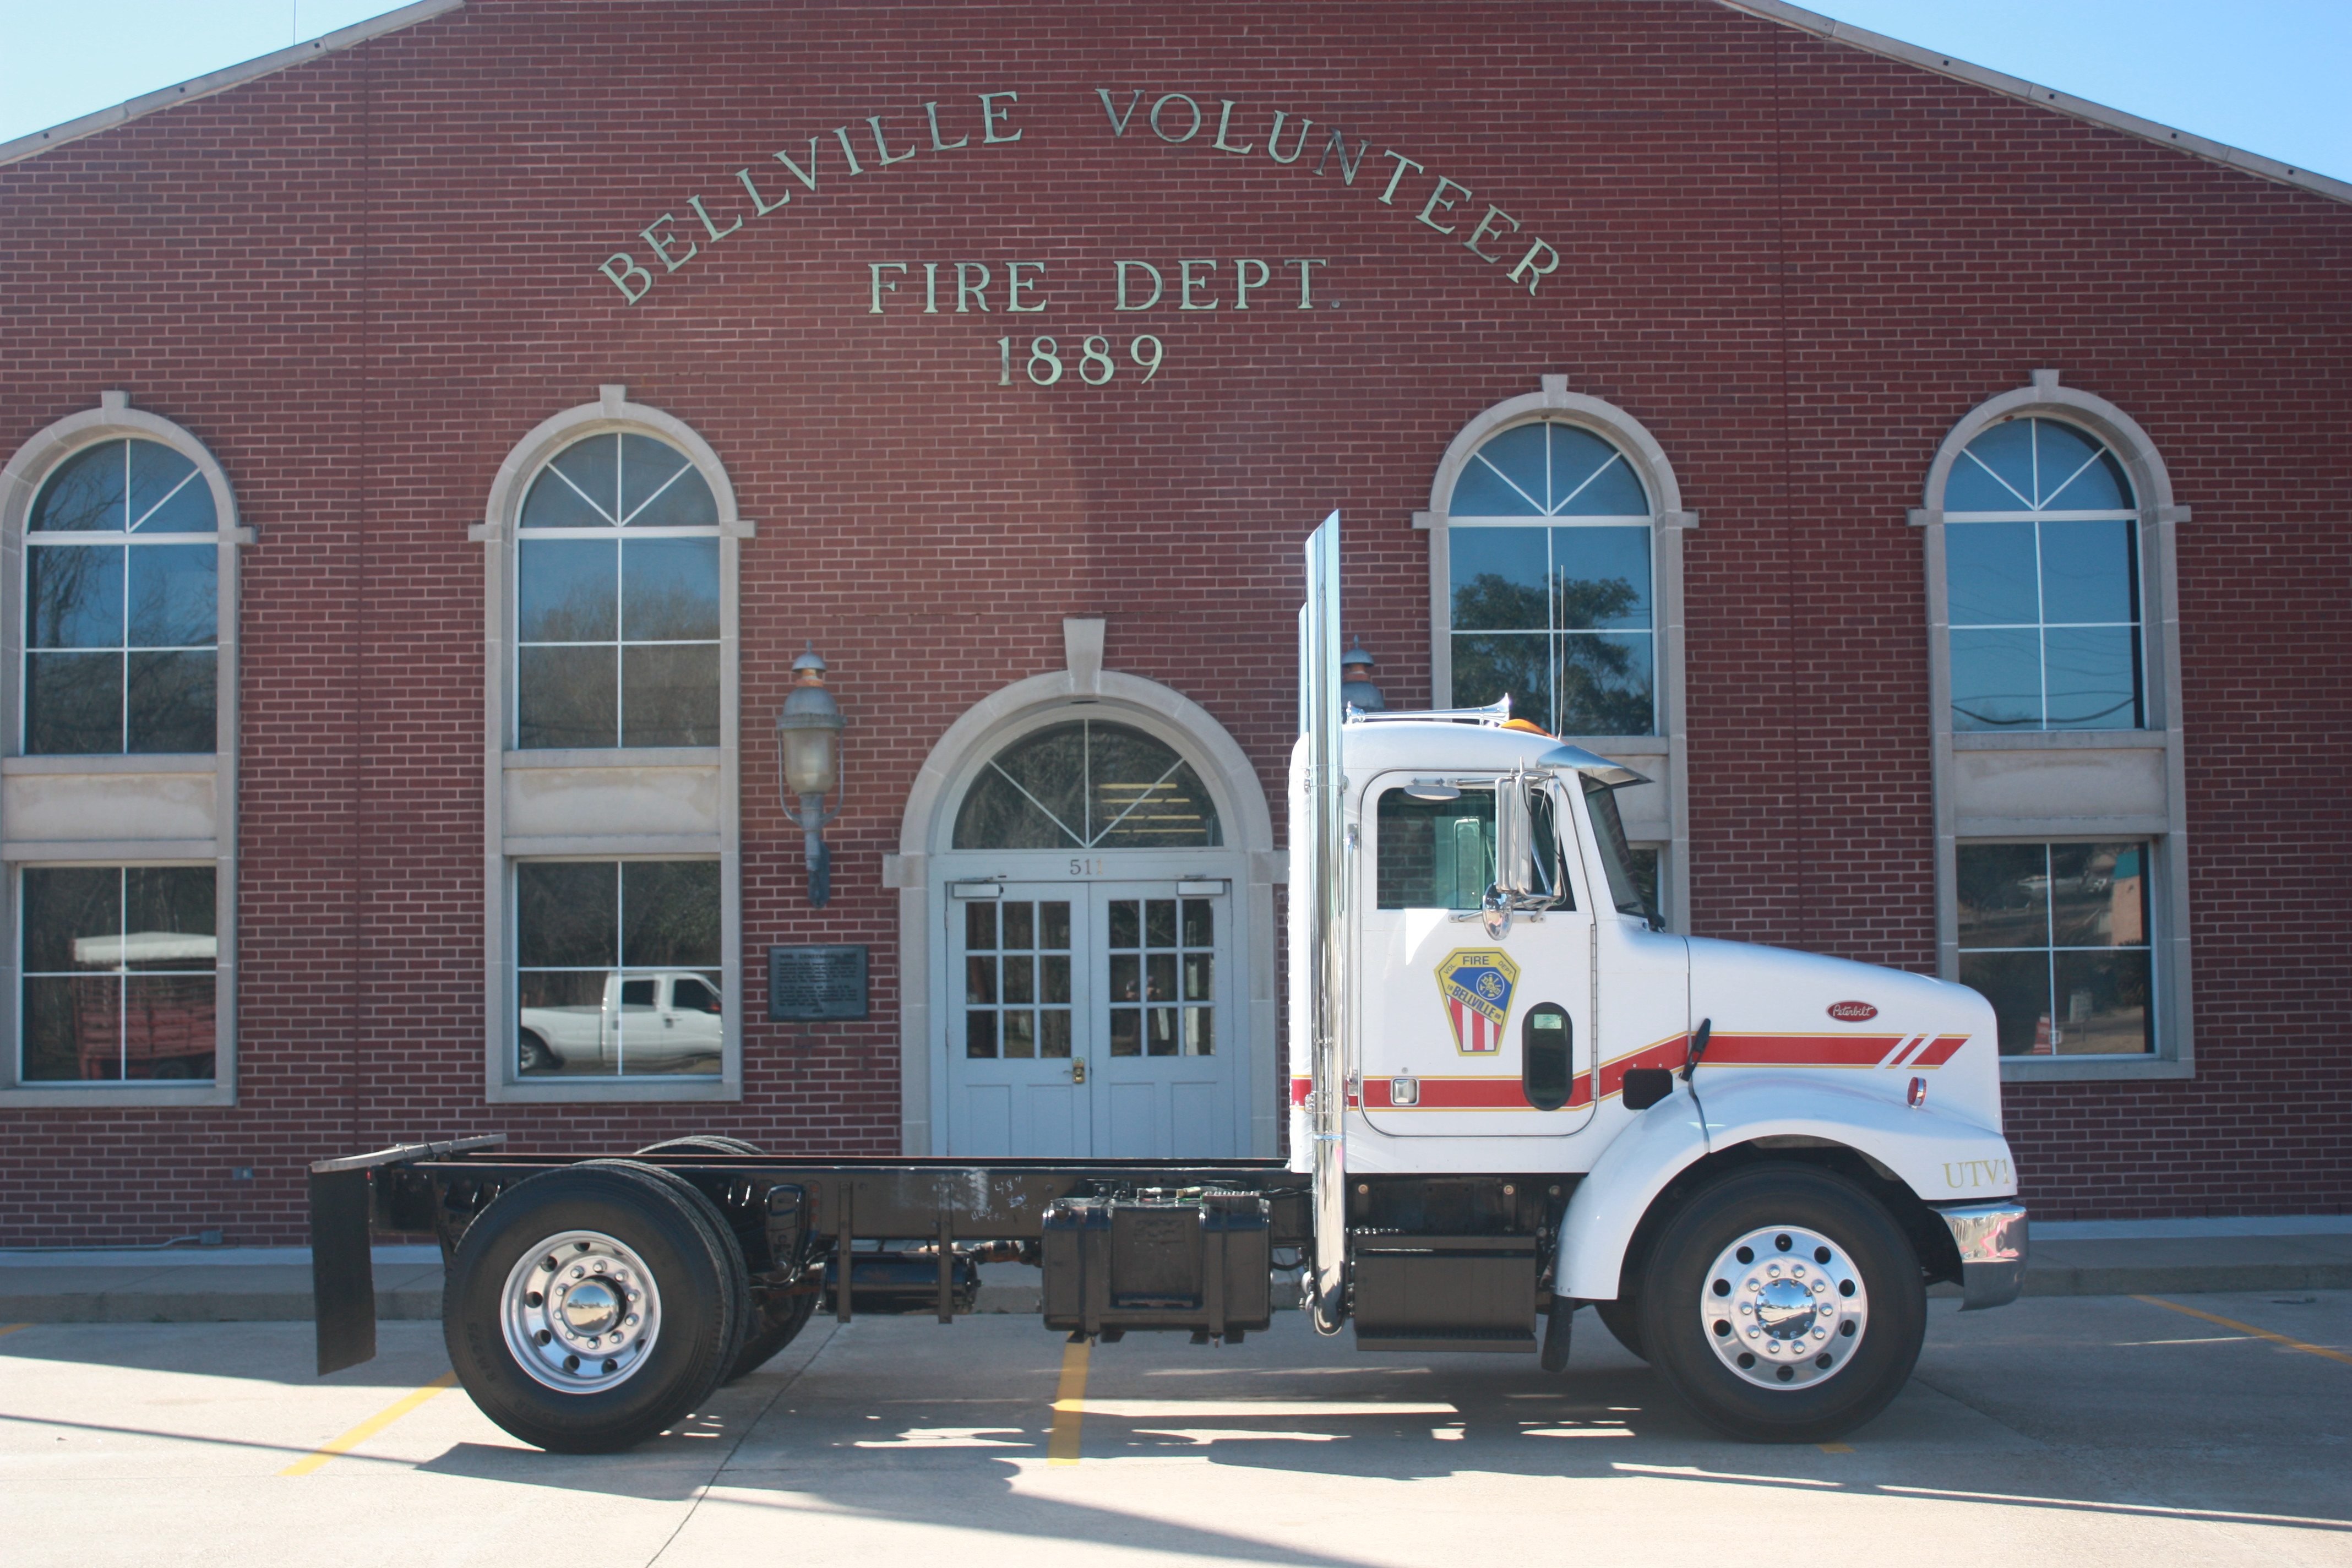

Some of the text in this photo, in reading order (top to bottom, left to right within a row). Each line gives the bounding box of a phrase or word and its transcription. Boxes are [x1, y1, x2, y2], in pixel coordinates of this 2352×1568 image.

[597, 88, 1560, 307] BELLVILLE VOLUNTEER
[868, 259, 1340, 314] FIRE DEPT.
[997, 334, 1163, 386] 1889
[1070, 858, 1103, 875] 511
[1462, 955, 1490, 965] FIRE
[1451, 986, 1496, 1019] BELLVILLE
[1832, 1004, 1874, 1017] Peterbilt
[1941, 1158, 2011, 1189] UTV1
